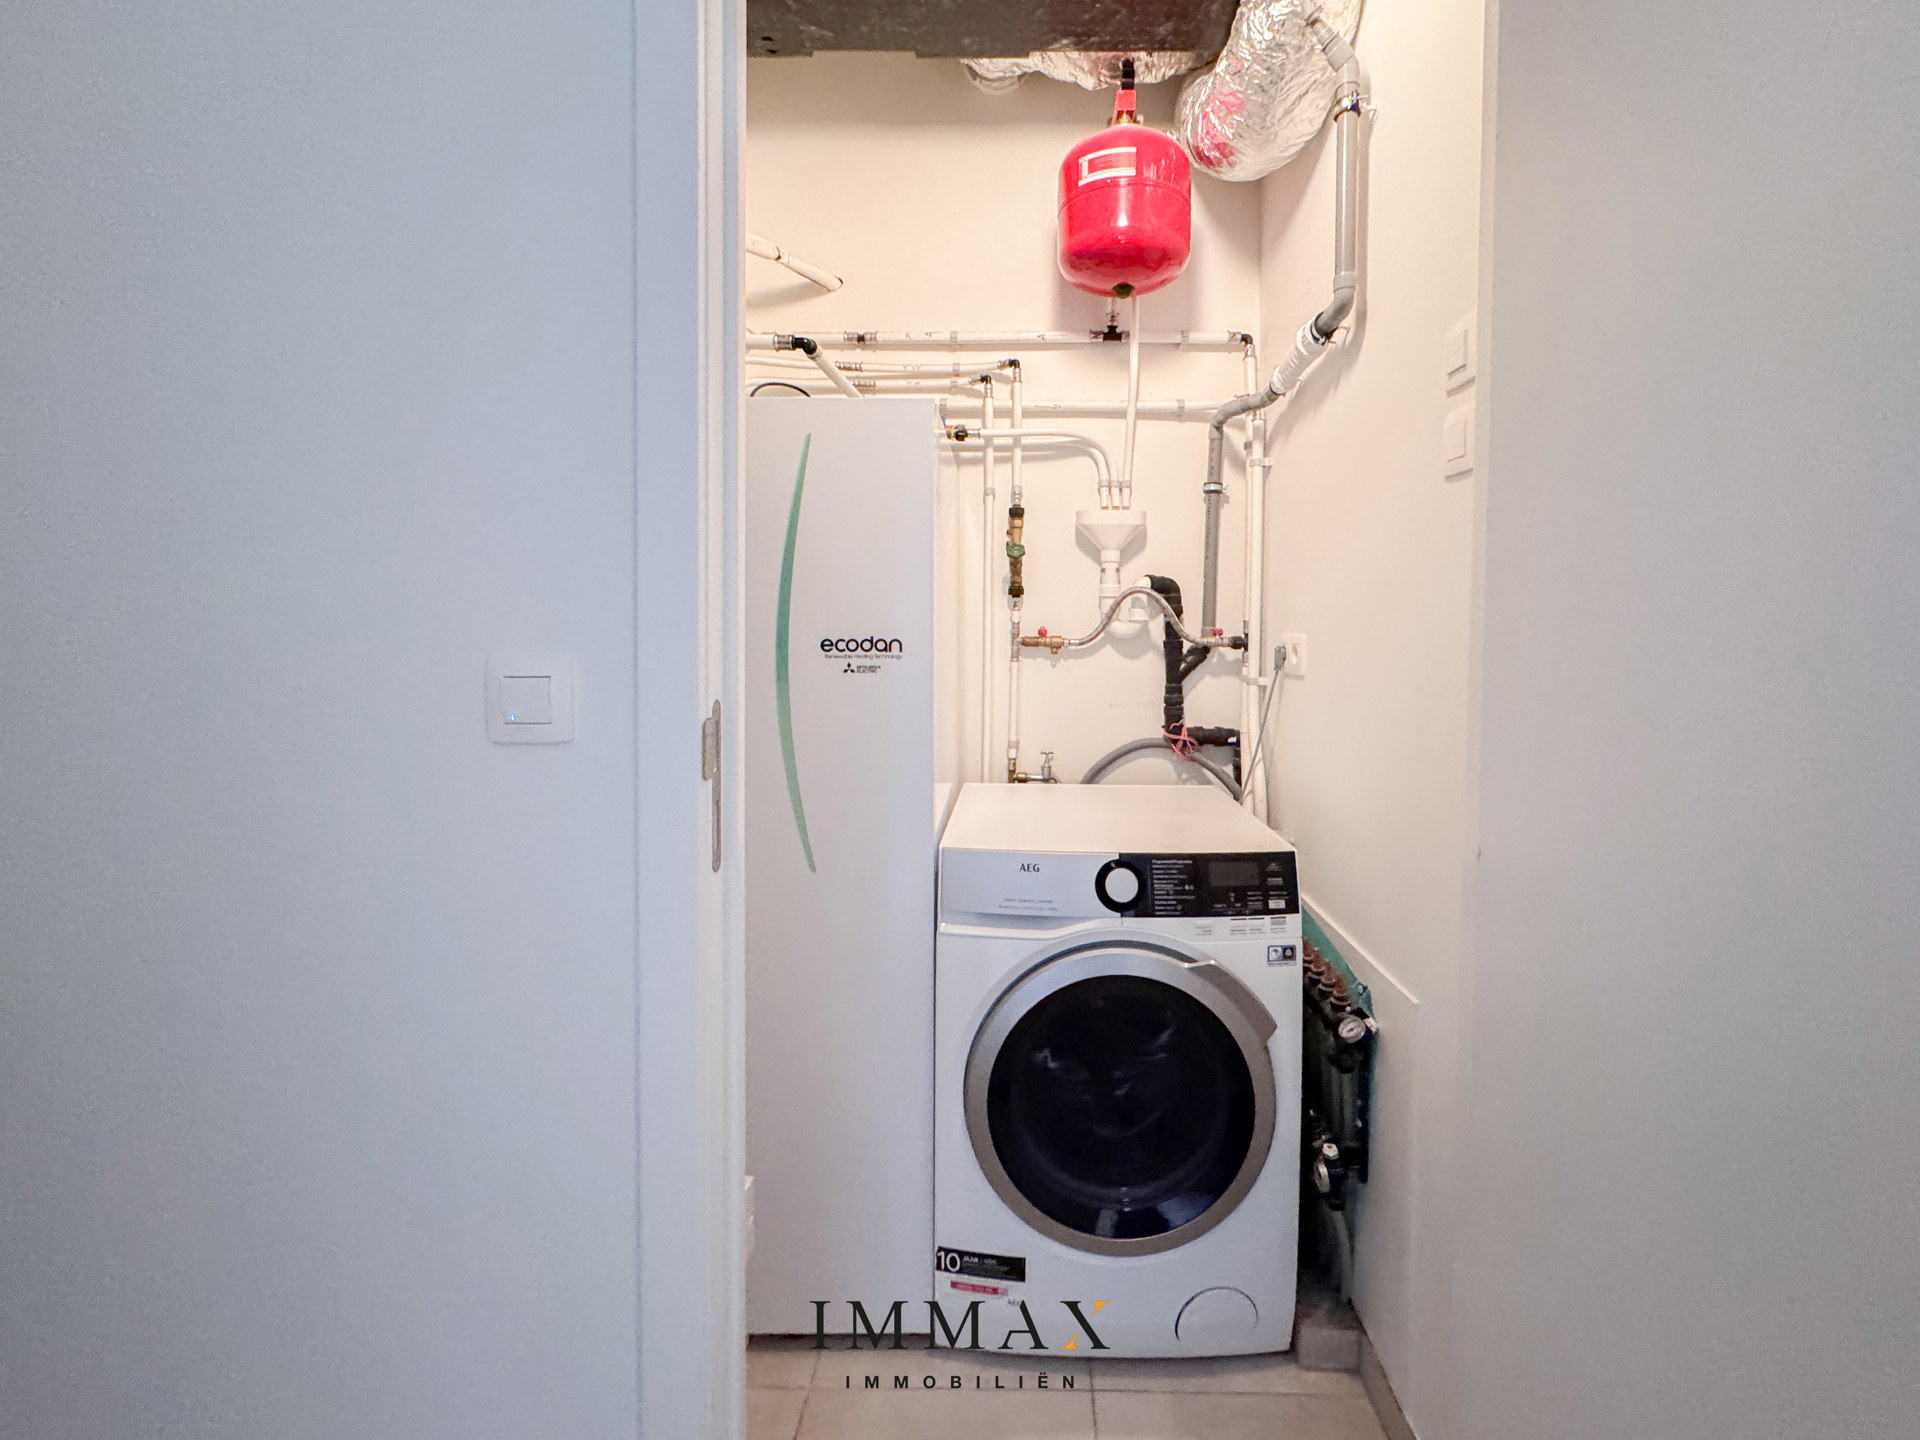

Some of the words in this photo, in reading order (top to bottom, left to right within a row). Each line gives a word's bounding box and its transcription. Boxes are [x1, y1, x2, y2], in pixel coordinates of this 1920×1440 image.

[820, 636, 903, 653] ecodan
[1019, 863, 1041, 873] AEG
[937, 1250, 961, 1273] 10
